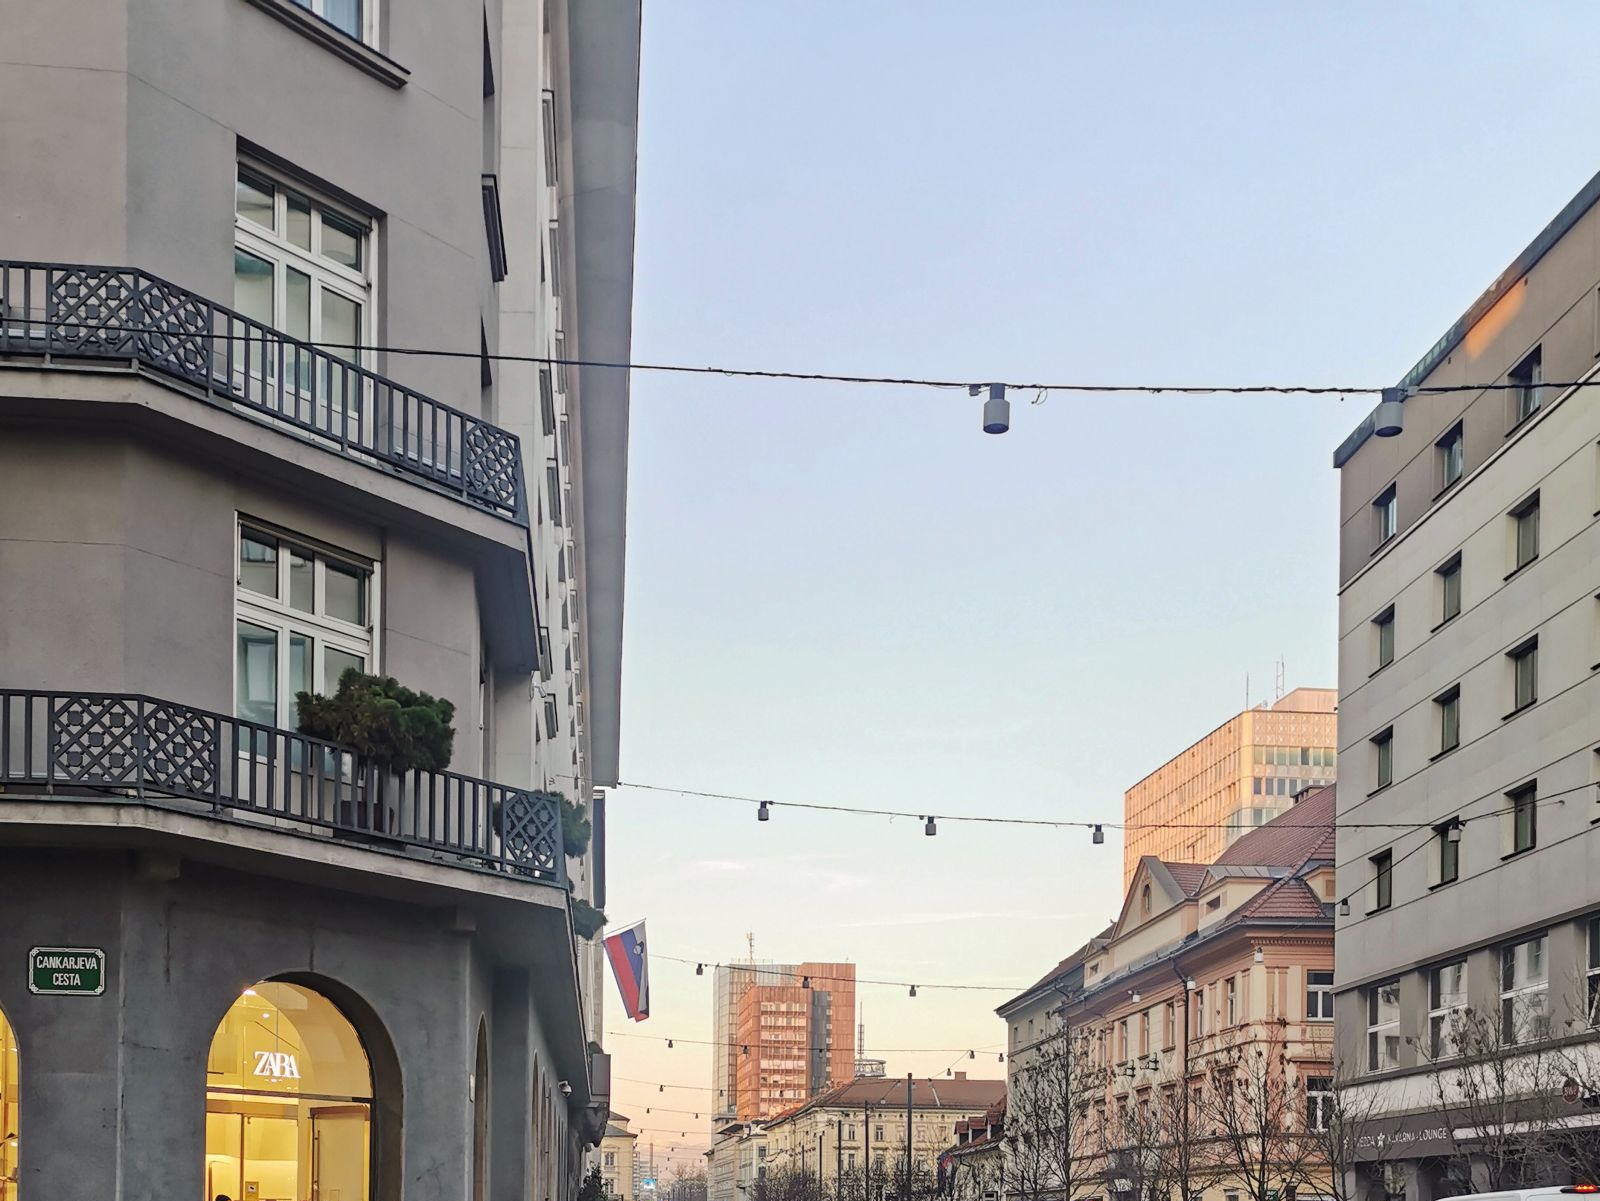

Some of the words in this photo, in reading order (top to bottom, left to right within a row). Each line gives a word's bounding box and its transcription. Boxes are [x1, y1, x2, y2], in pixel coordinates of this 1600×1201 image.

[36, 956, 98, 970] CANKARJEVA
[52, 973, 81, 986] CESTA
[253, 1051, 302, 1078] ZARA
